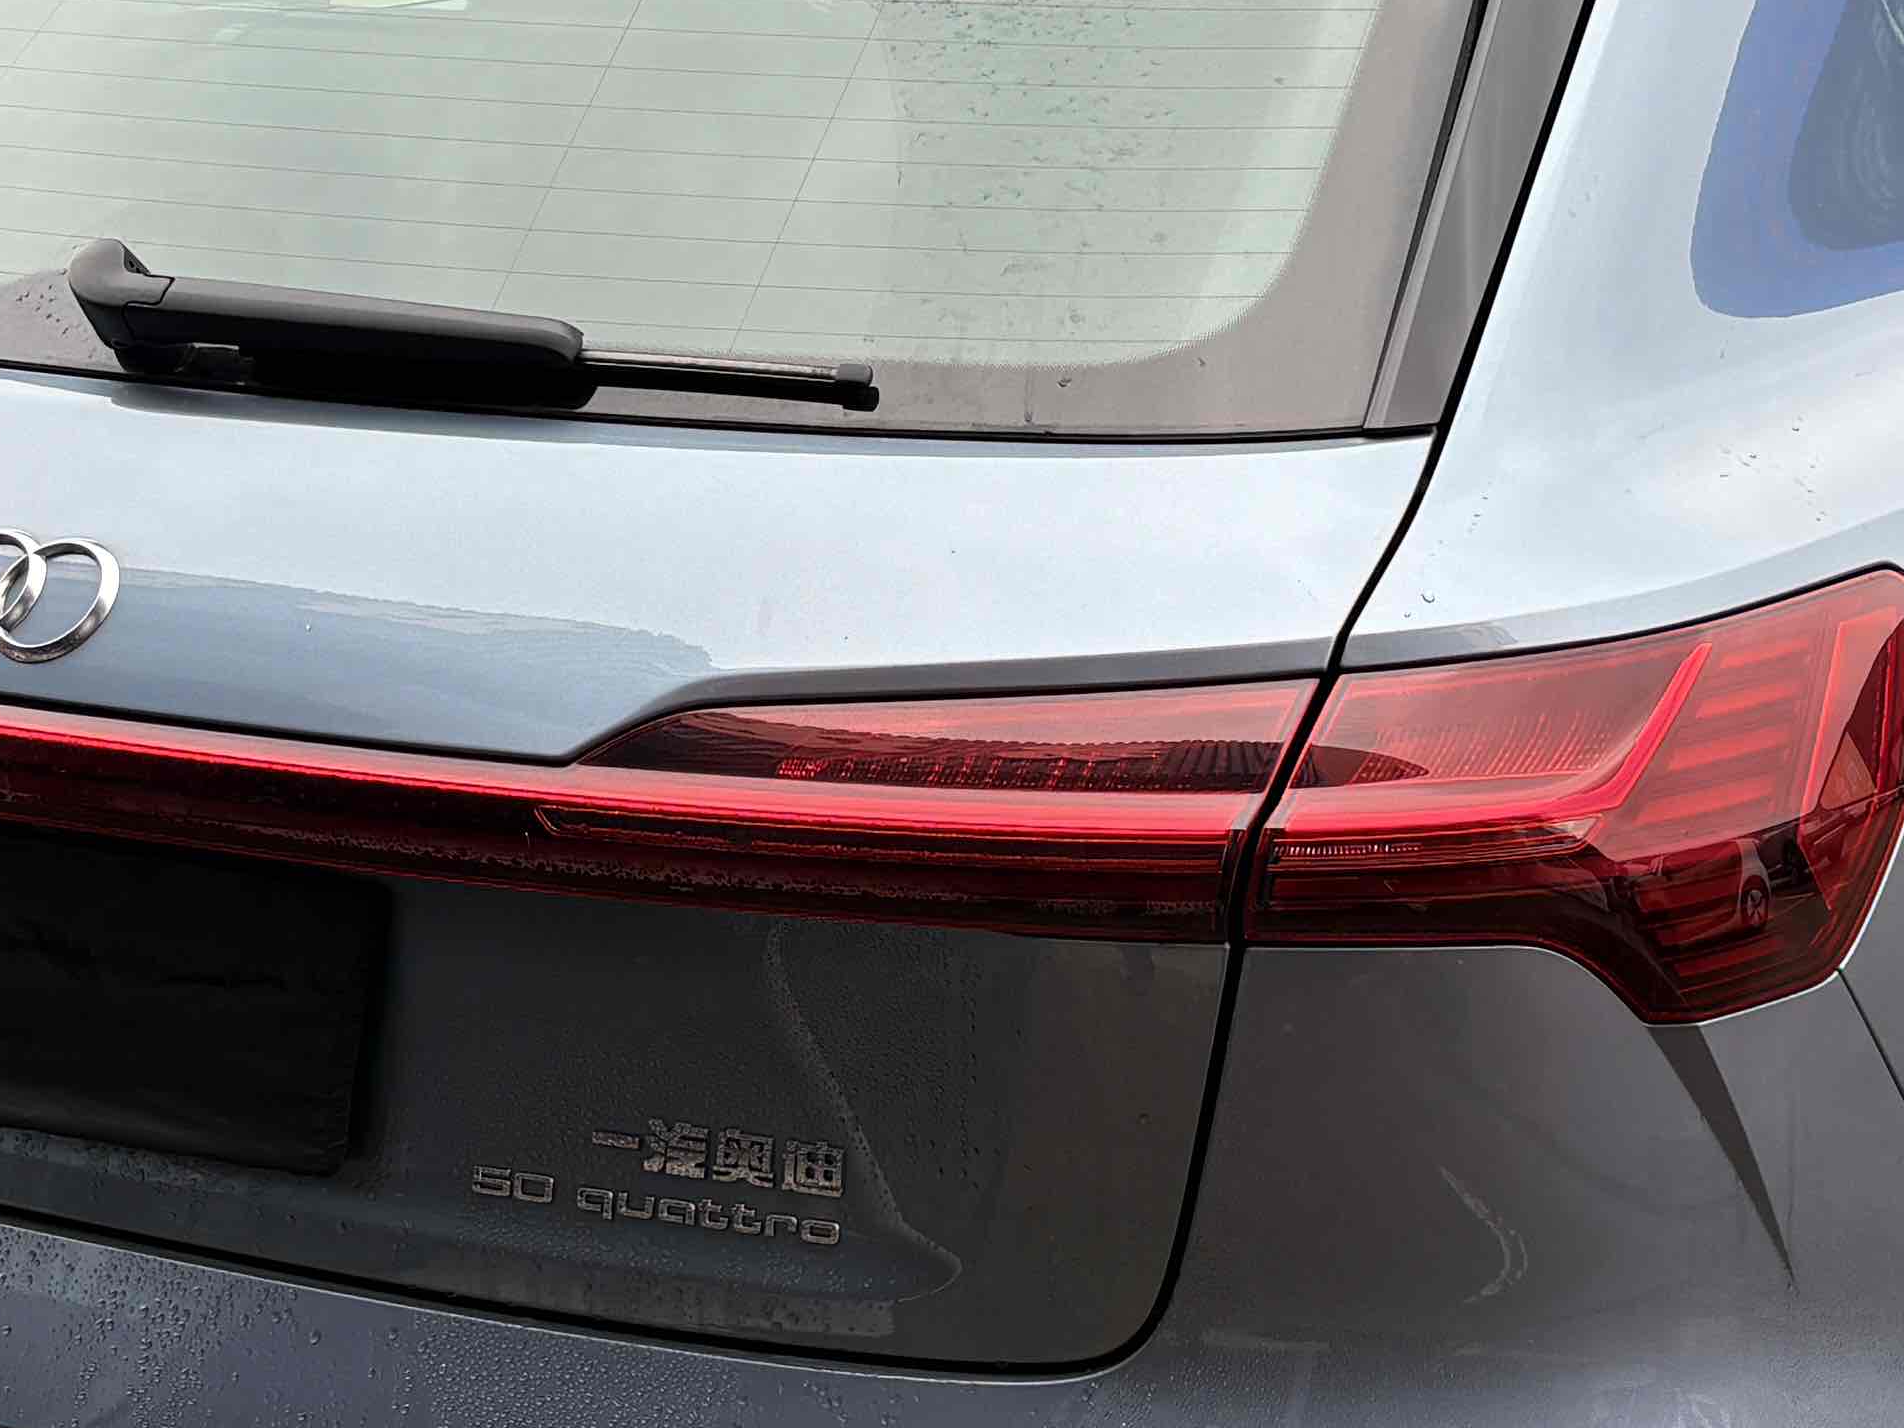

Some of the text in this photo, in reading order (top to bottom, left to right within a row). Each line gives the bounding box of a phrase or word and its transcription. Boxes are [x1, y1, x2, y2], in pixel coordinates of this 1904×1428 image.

[592, 1118, 845, 1198] 一汽奥迪
[576, 1186, 841, 1245] quattro
